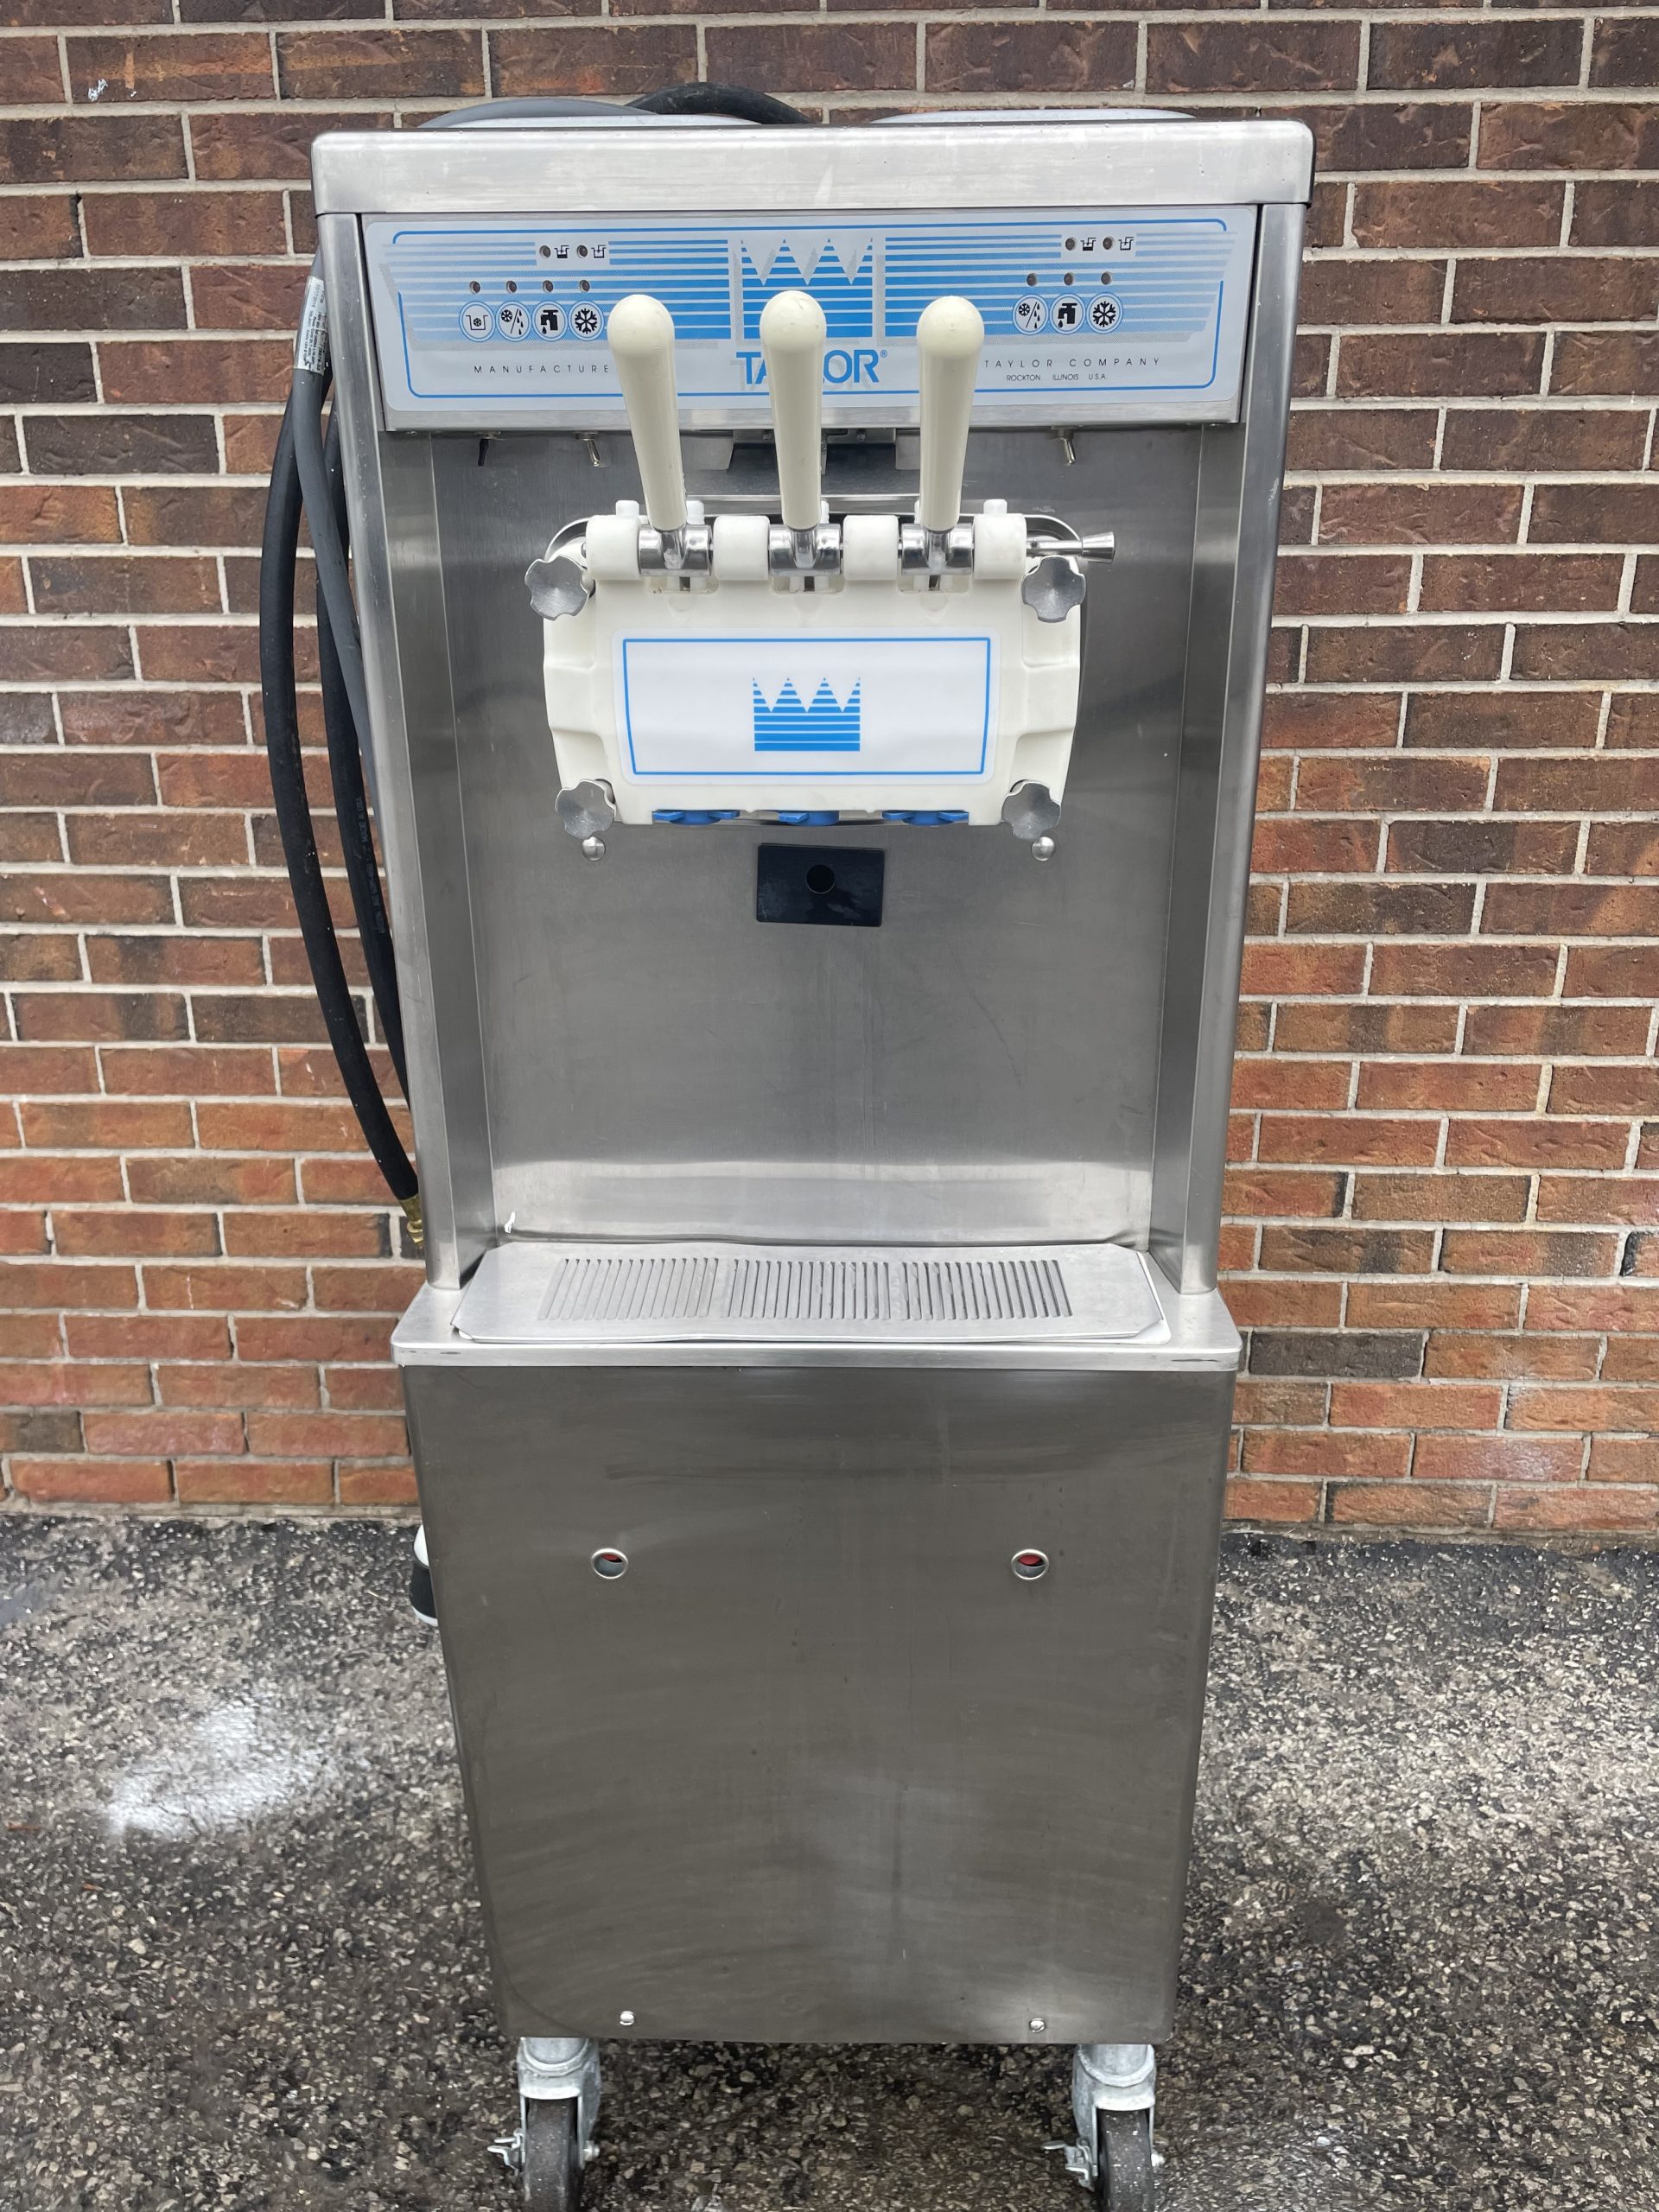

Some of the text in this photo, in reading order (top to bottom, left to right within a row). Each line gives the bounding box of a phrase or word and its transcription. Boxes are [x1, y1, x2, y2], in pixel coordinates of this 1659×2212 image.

[984, 357, 1160, 369] TAYLOR COMPANY
[1052, 372, 1080, 382] ILLINOIS
